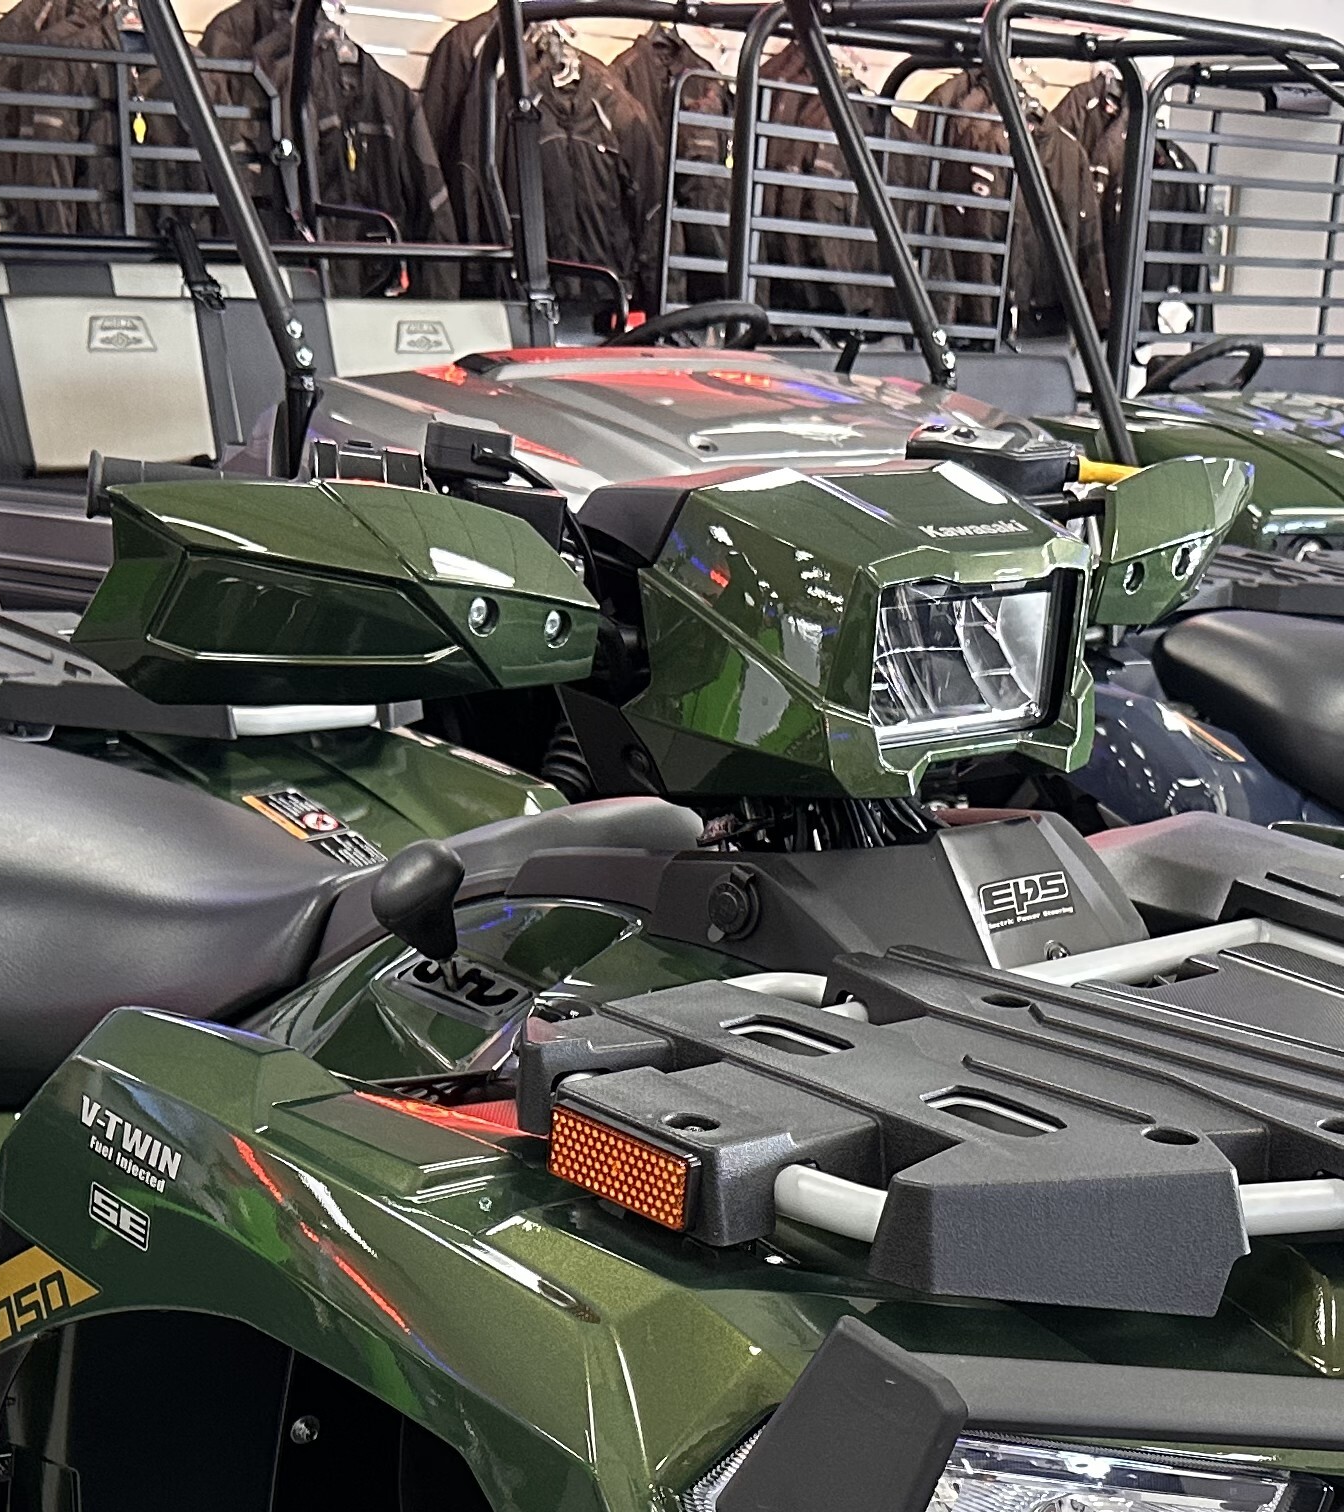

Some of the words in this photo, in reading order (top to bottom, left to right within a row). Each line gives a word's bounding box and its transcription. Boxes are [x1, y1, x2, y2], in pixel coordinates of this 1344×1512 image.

[918, 519, 1030, 539] Kawasaki
[979, 872, 1069, 915] EPS
[1016, 913, 1041, 923] Power
[80, 1094, 182, 1181] V-TWIN
[89, 1134, 114, 1161] Fuel
[115, 1151, 166, 1194] Injected
[92, 1189, 148, 1244] SE
